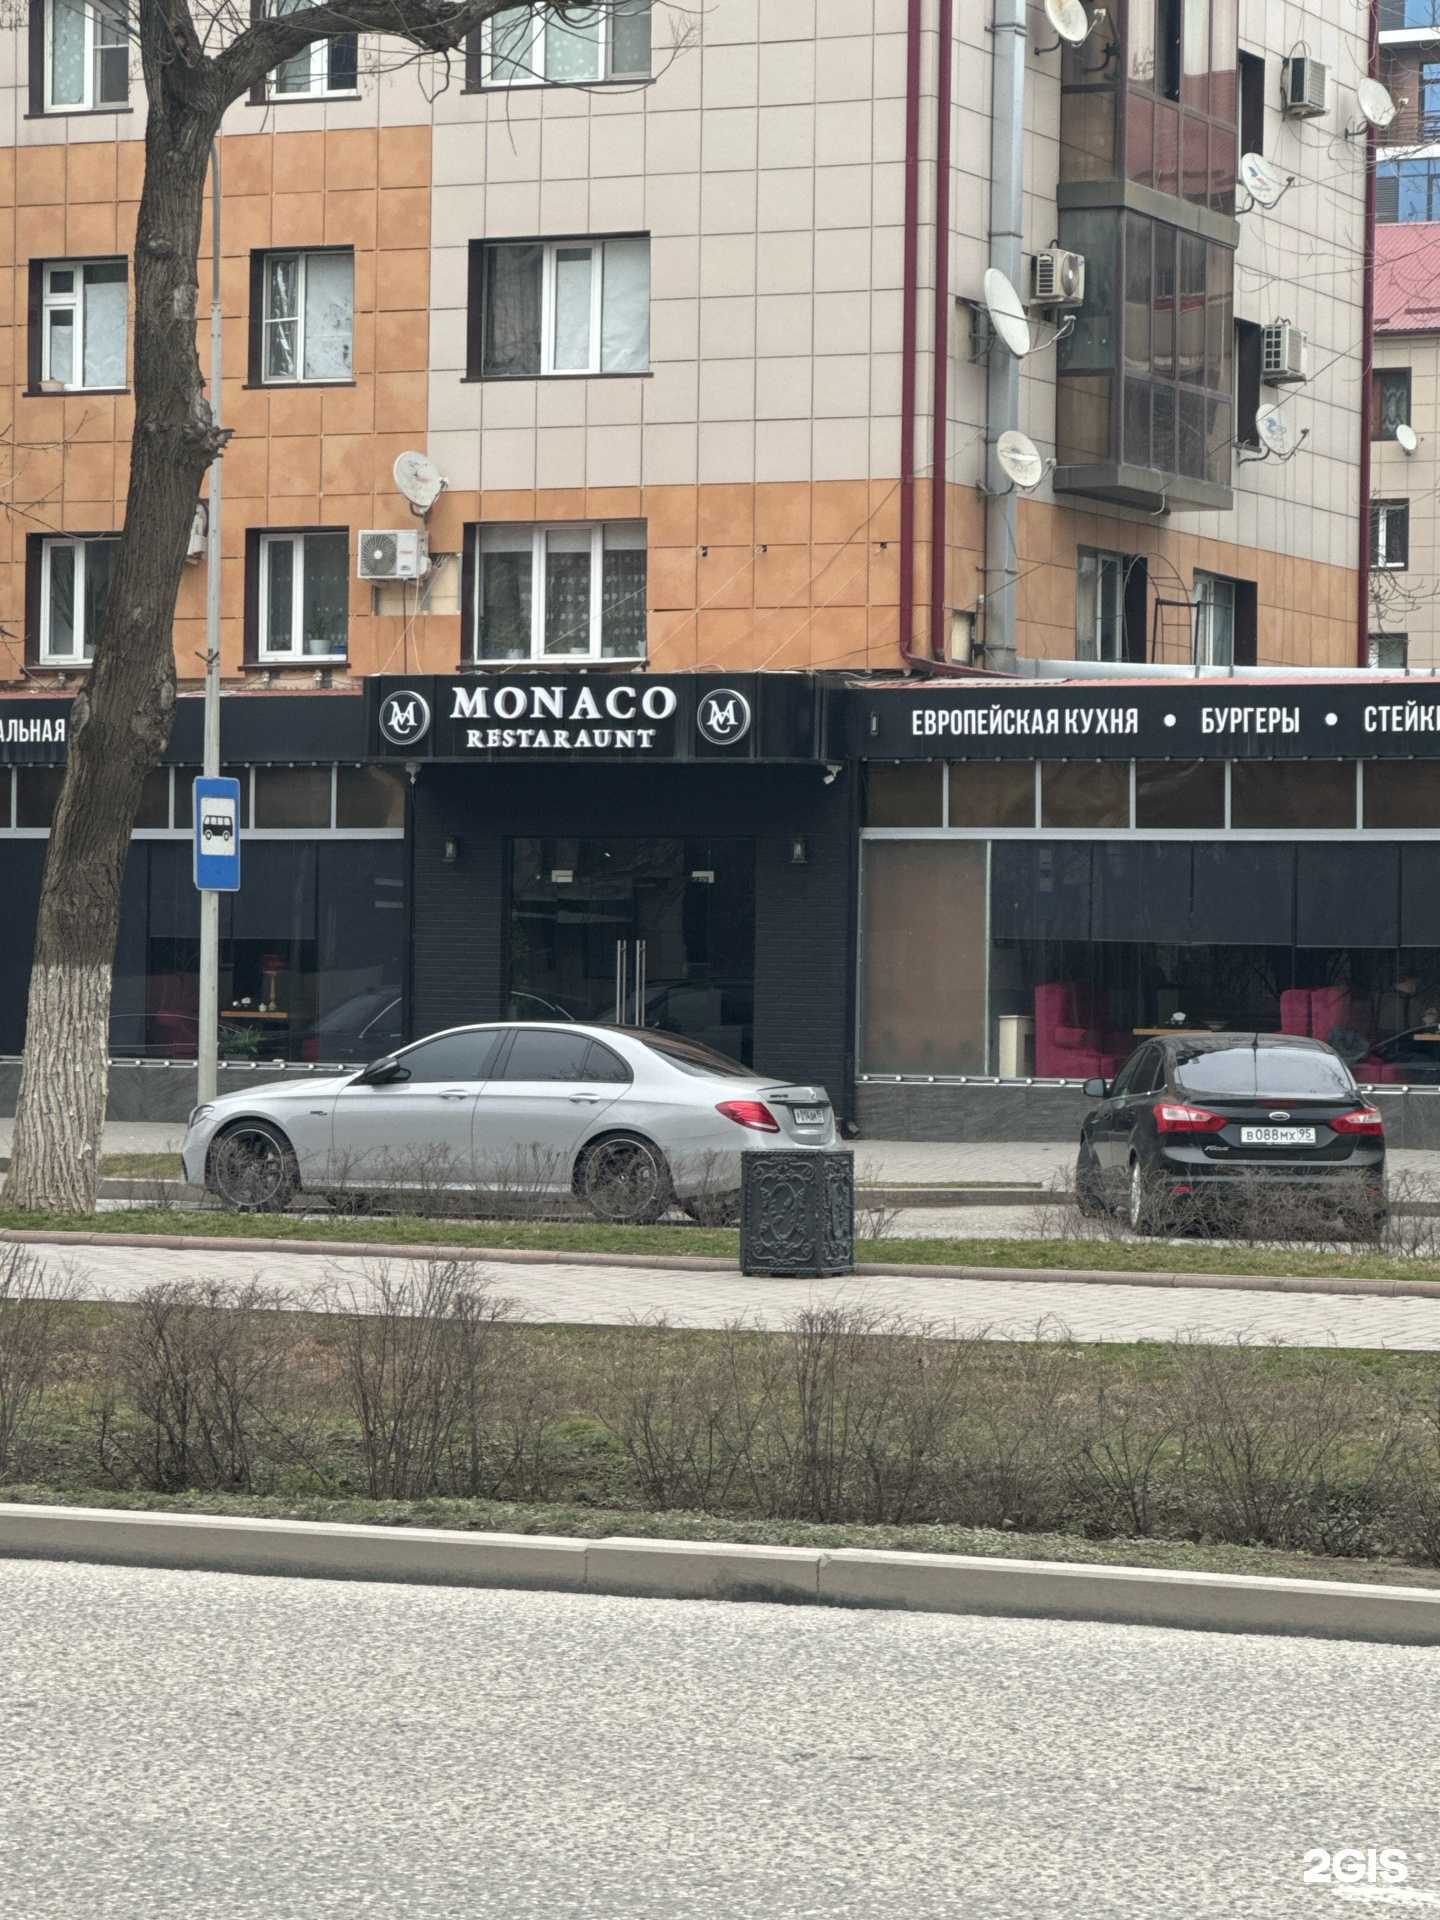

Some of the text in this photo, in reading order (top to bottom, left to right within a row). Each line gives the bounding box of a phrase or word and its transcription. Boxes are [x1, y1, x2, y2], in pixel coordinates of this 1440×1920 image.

[450, 686, 677, 719] MONACO
[912, 704, 1059, 735] ЕВРОПЕЙСКАЯ
[1065, 708, 1138, 734] КУХНЯ
[1202, 707, 1300, 733] БУРГЕРЫ
[466, 729, 656, 748] RESTARAUNT
